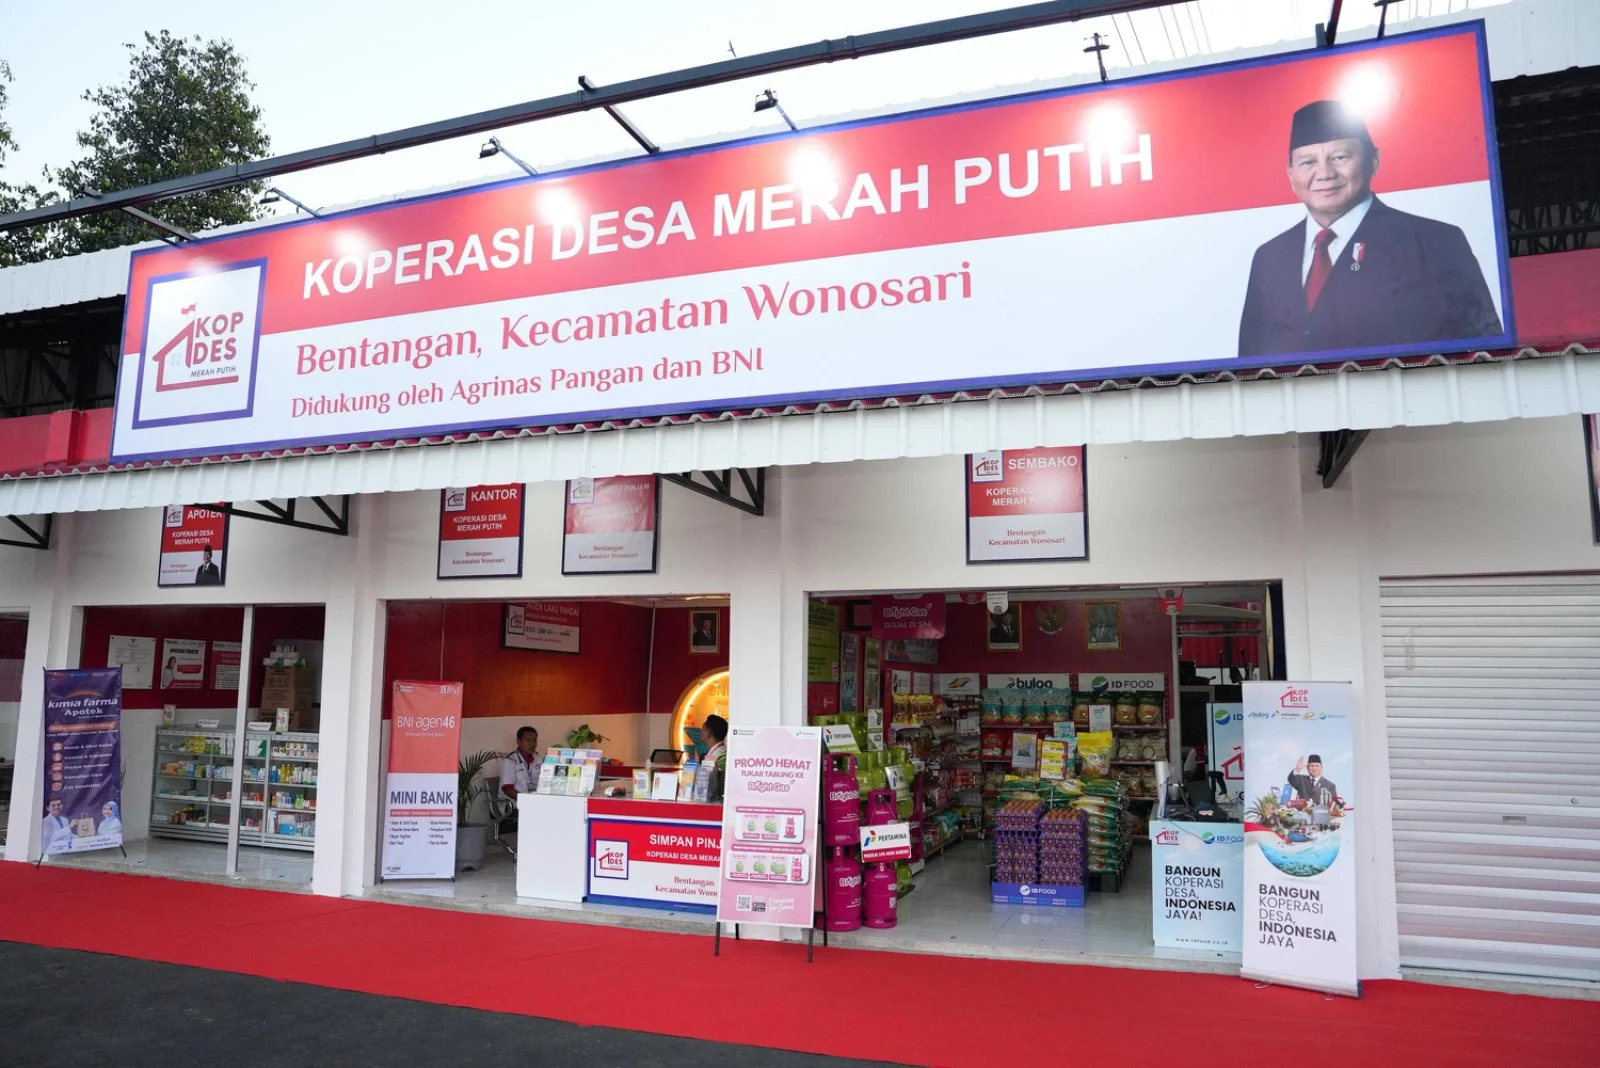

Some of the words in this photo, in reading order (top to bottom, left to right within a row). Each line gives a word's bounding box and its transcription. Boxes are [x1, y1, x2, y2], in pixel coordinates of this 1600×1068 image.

[303, 224, 535, 299] KOPERASI
[551, 200, 696, 257] DESA
[712, 164, 929, 237] MERAH
[953, 133, 1154, 205] PUTIH
[296, 329, 482, 375] Bentangan,
[501, 296, 728, 350] Kecamatan
[742, 261, 972, 321] Wonosari
[195, 311, 244, 338] KOP
[193, 337, 237, 365] DES
[191, 368, 215, 378] MERAH
[216, 366, 237, 375] PUTIH
[291, 392, 391, 418] Didukung
[397, 382, 444, 406] oleh
[450, 375, 542, 404] Agrinas
[550, 363, 644, 395] Pangan
[652, 356, 702, 380] dan
[711, 347, 764, 376] BNI
[1008, 455, 1078, 470] SEMBAKO
[624, 483, 650, 491] PINJAM
[986, 486, 1035, 497] KOPERAS
[471, 488, 518, 502] KANTOR
[992, 497, 1027, 506] MERAH
[453, 514, 487, 523] KOPERASI
[488, 513, 507, 521] DESA
[172, 530, 198, 538] KOPERASI
[457, 524, 480, 532] MERAH
[1007, 529, 1046, 537] Bentangan
[174, 538, 193, 546] MERAH
[526, 601, 543, 611] AGEN
[544, 603, 559, 613] LAKU
[560, 606, 579, 616] PANDAI
[883, 606, 910, 619] Bright
[910, 606, 928, 617] Gas
[919, 620, 932, 629] SINI
[1016, 677, 1053, 689] bulog
[1111, 680, 1122, 688] ID
[1124, 680, 1154, 689] FOOD
[447, 685, 459, 694] BNI
[48, 700, 81, 708] kimia
[83, 698, 118, 707] farma
[64, 708, 103, 717] Apotek
[1252, 711, 1269, 719] bulog
[397, 716, 413, 728] BNI
[415, 716, 455, 731] agen46
[734, 757, 774, 768] PROMO
[775, 758, 812, 770] HEMAT
[741, 770, 764, 778] TUKAR
[765, 771, 794, 779] TABUNG
[748, 781, 773, 793] Bright
[773, 782, 790, 792] Gas
[390, 791, 417, 804] MINI
[420, 791, 453, 804] BANK
[830, 791, 852, 802] Bright
[649, 834, 693, 847] SIMPAN
[878, 833, 908, 842] PERTAMINA
[646, 850, 679, 859] KOPERASI
[680, 852, 698, 860] DESA
[1165, 865, 1220, 877] BANGUN
[674, 876, 715, 887] Bentangan
[1165, 876, 1224, 889] KOPERASI
[655, 885, 696, 895] Kecamatan
[1165, 887, 1199, 899] DESA,
[1259, 883, 1320, 901] BANGUN
[1165, 898, 1236, 912] INDONESIA
[1259, 896, 1323, 914] KOPERASI
[1165, 909, 1202, 921] JAYA!
[1259, 908, 1296, 925] DESA,
[1259, 920, 1337, 942] INDONESIA
[1259, 933, 1295, 949] JAYA
